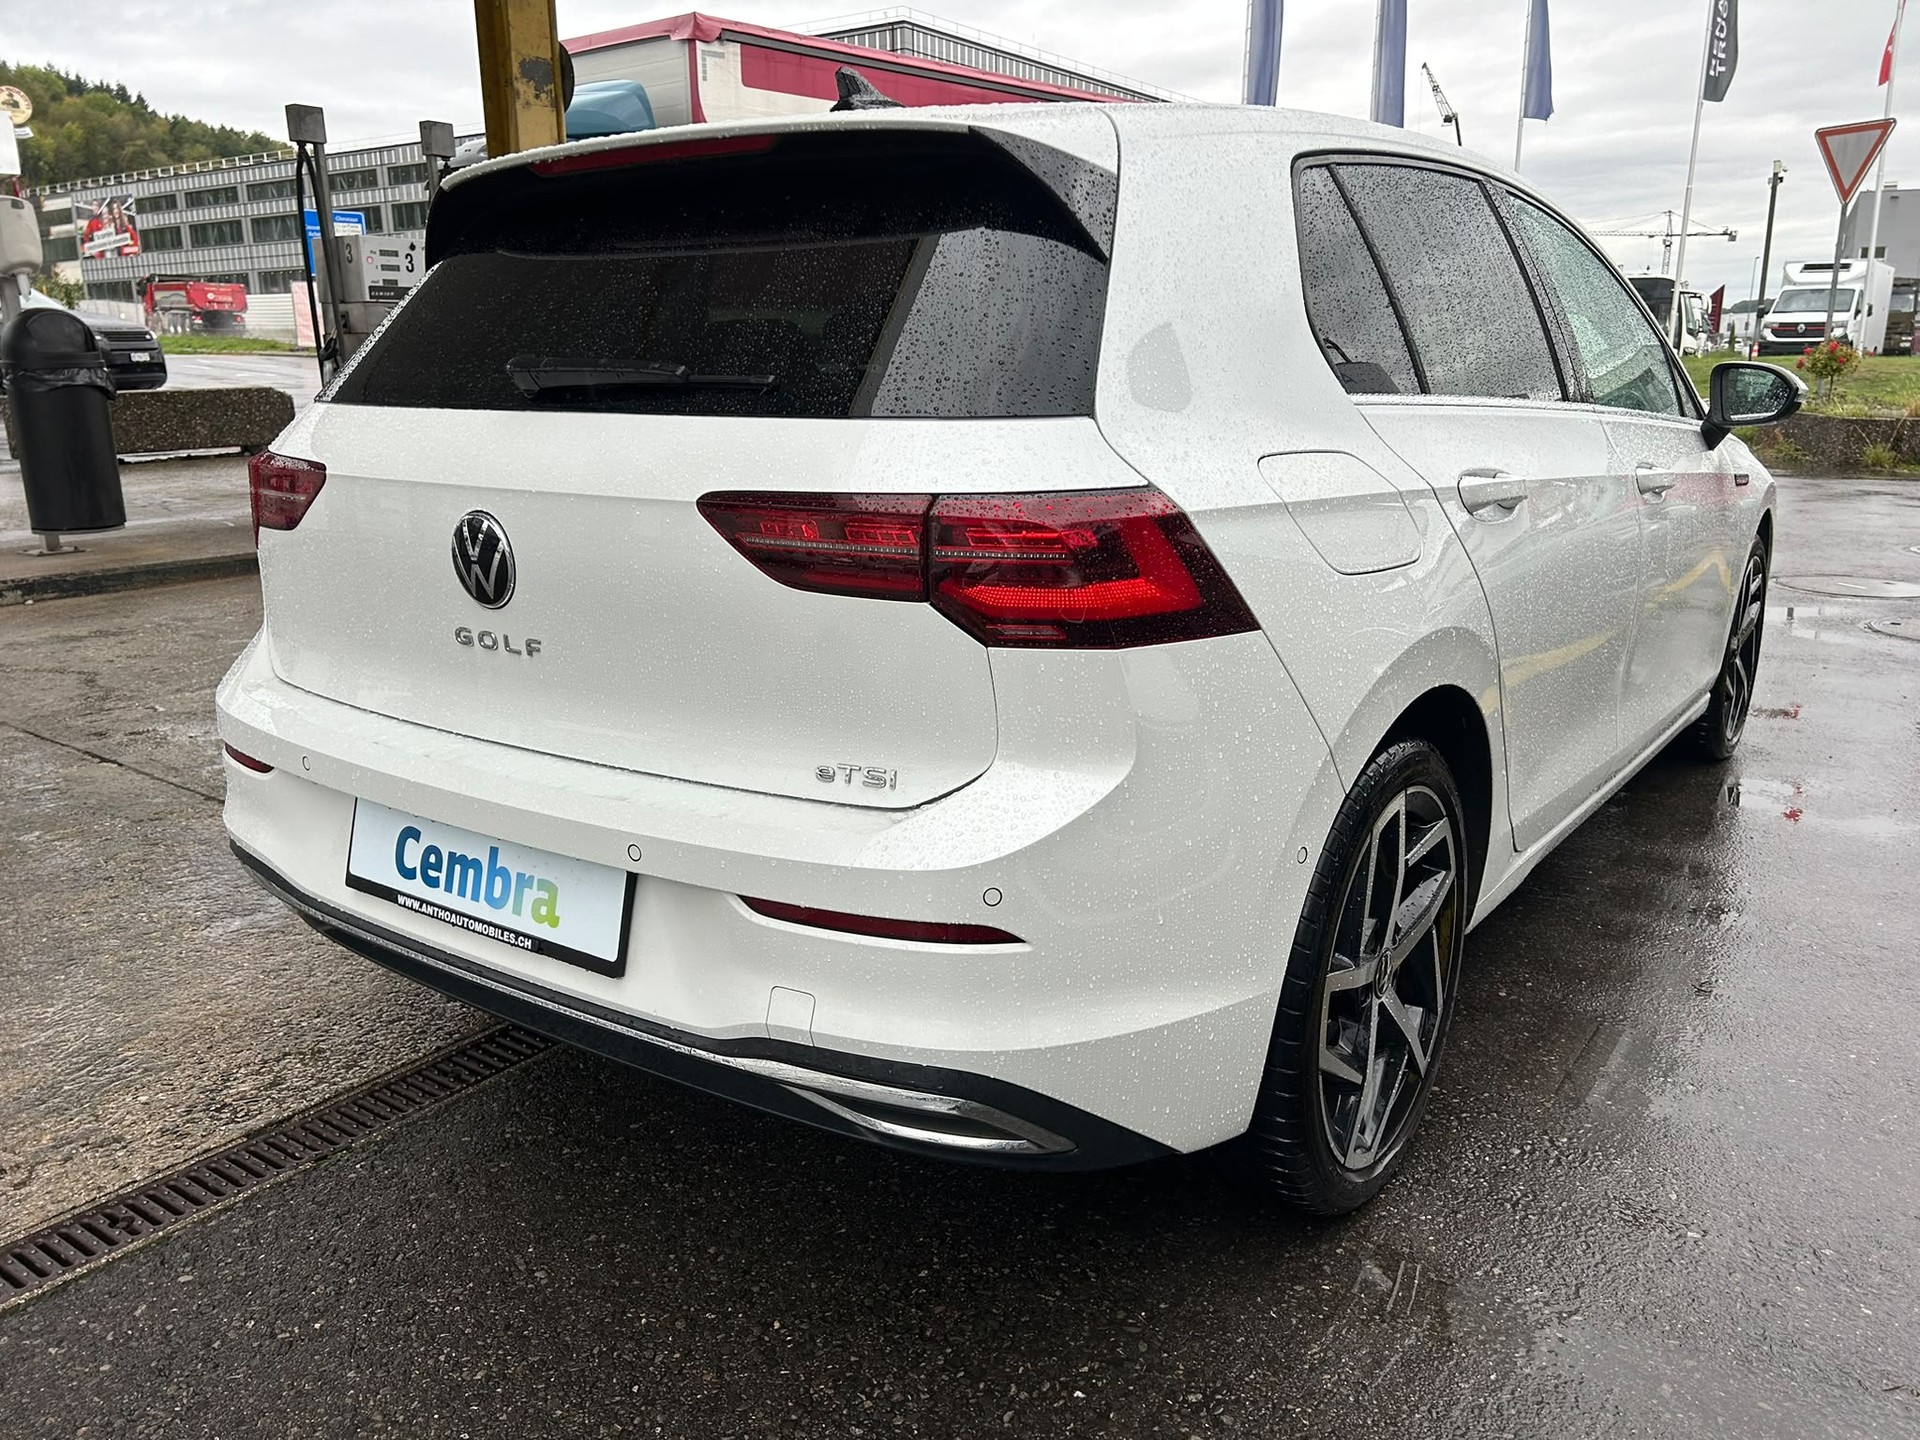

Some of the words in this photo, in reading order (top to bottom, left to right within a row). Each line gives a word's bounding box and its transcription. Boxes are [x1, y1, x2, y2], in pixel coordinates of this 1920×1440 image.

[346, 243, 353, 264] 3
[405, 253, 415, 273] 3
[454, 626, 542, 658] GOLF
[815, 762, 898, 792] eTSI
[395, 825, 560, 929] Cembra
[397, 894, 533, 950] WWW.ANTHOAUTOMOBILES.CH
